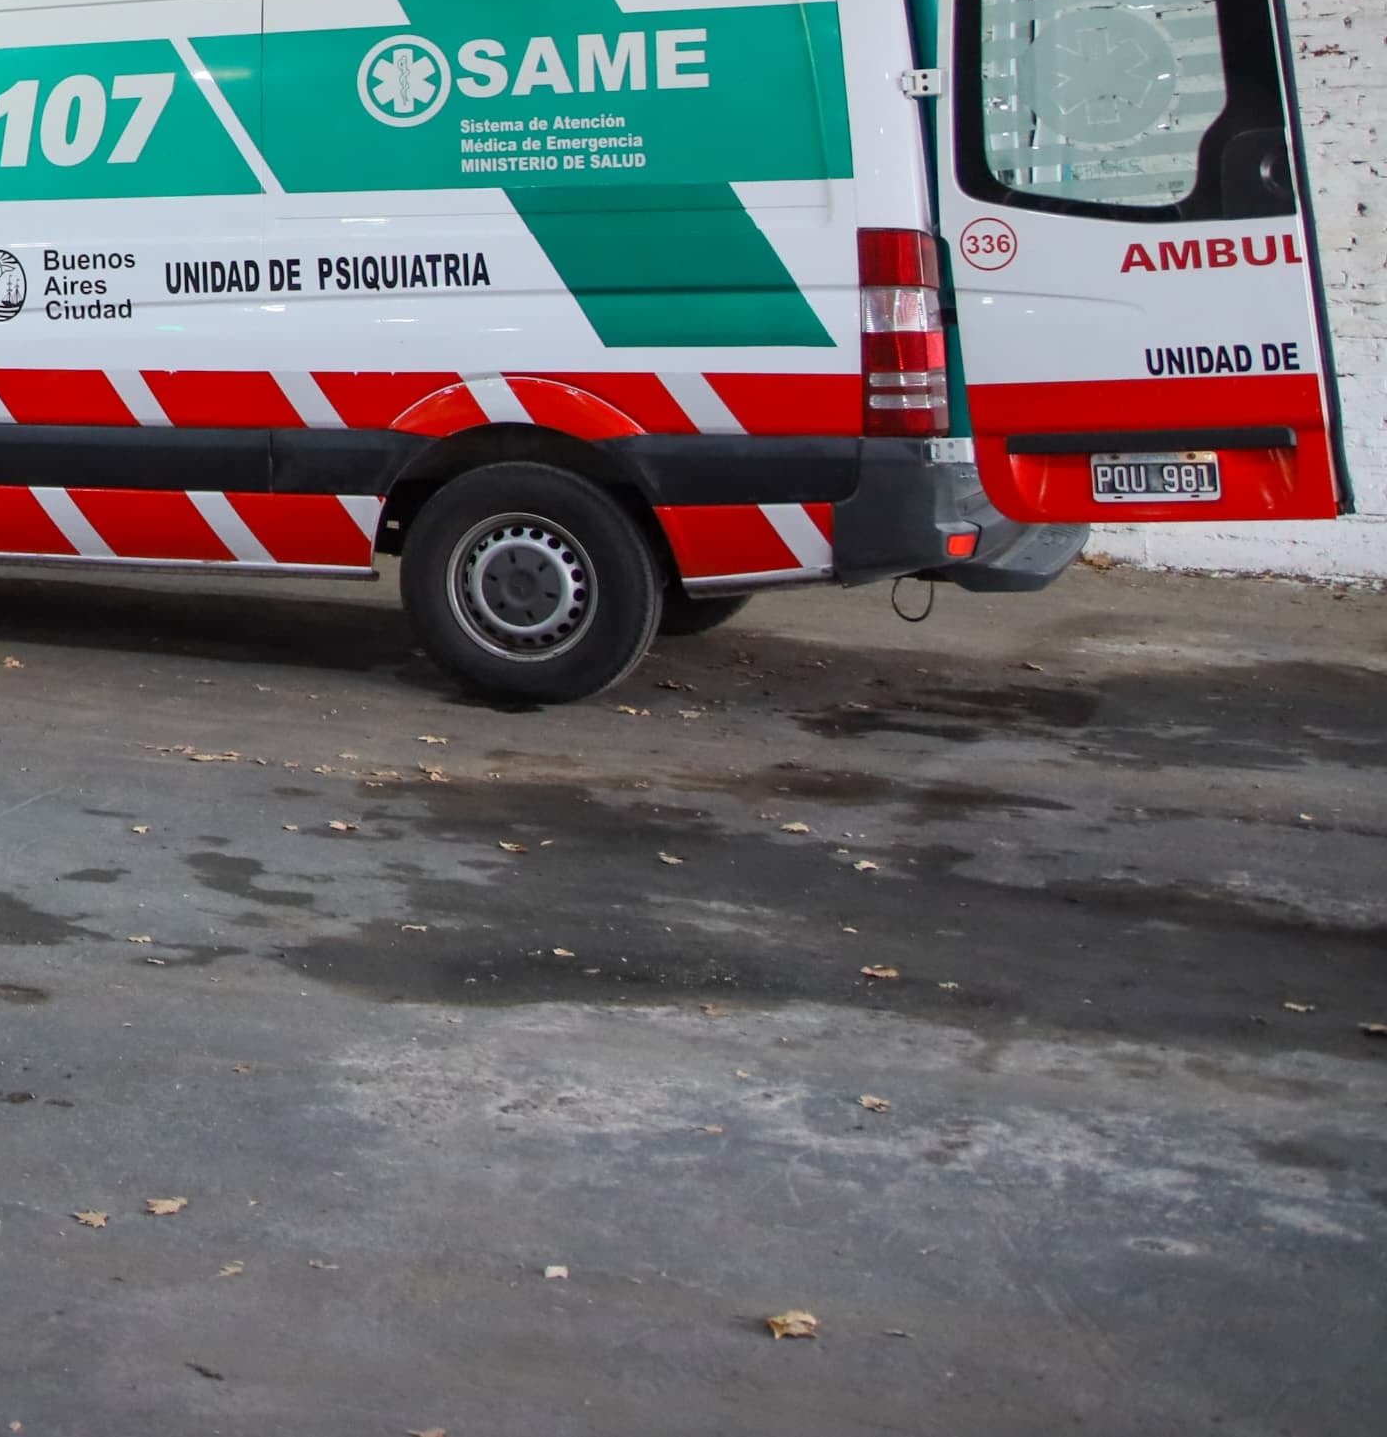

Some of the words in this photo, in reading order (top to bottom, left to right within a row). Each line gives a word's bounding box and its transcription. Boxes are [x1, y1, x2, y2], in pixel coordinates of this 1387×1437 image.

[456, 28, 711, 99] SAME
[460, 118, 524, 134] Sistema
[528, 116, 548, 131] de
[552, 113, 626, 130] Atención
[460, 137, 518, 153] Médica
[521, 136, 542, 152] de
[546, 132, 643, 152] Emergencia
[461, 156, 558, 173] MINISTERIO
[562, 155, 585, 170] DE
[589, 153, 647, 169] SALUD
[966, 233, 1011, 255] 336
[1120, 234, 1303, 274] AMBUL
[42, 249, 136, 271] Buenos
[164, 259, 261, 294] UNIDAD
[269, 258, 302, 292] DE
[317, 252, 491, 292] PSIQUIATRIA
[43, 275, 108, 297] Aires
[45, 297, 133, 320] Ciudad
[1144, 344, 1253, 376] UNIDAD
[1261, 342, 1301, 372] DE
[1096, 465, 1147, 493] PQU
[1162, 464, 1215, 493] 981
